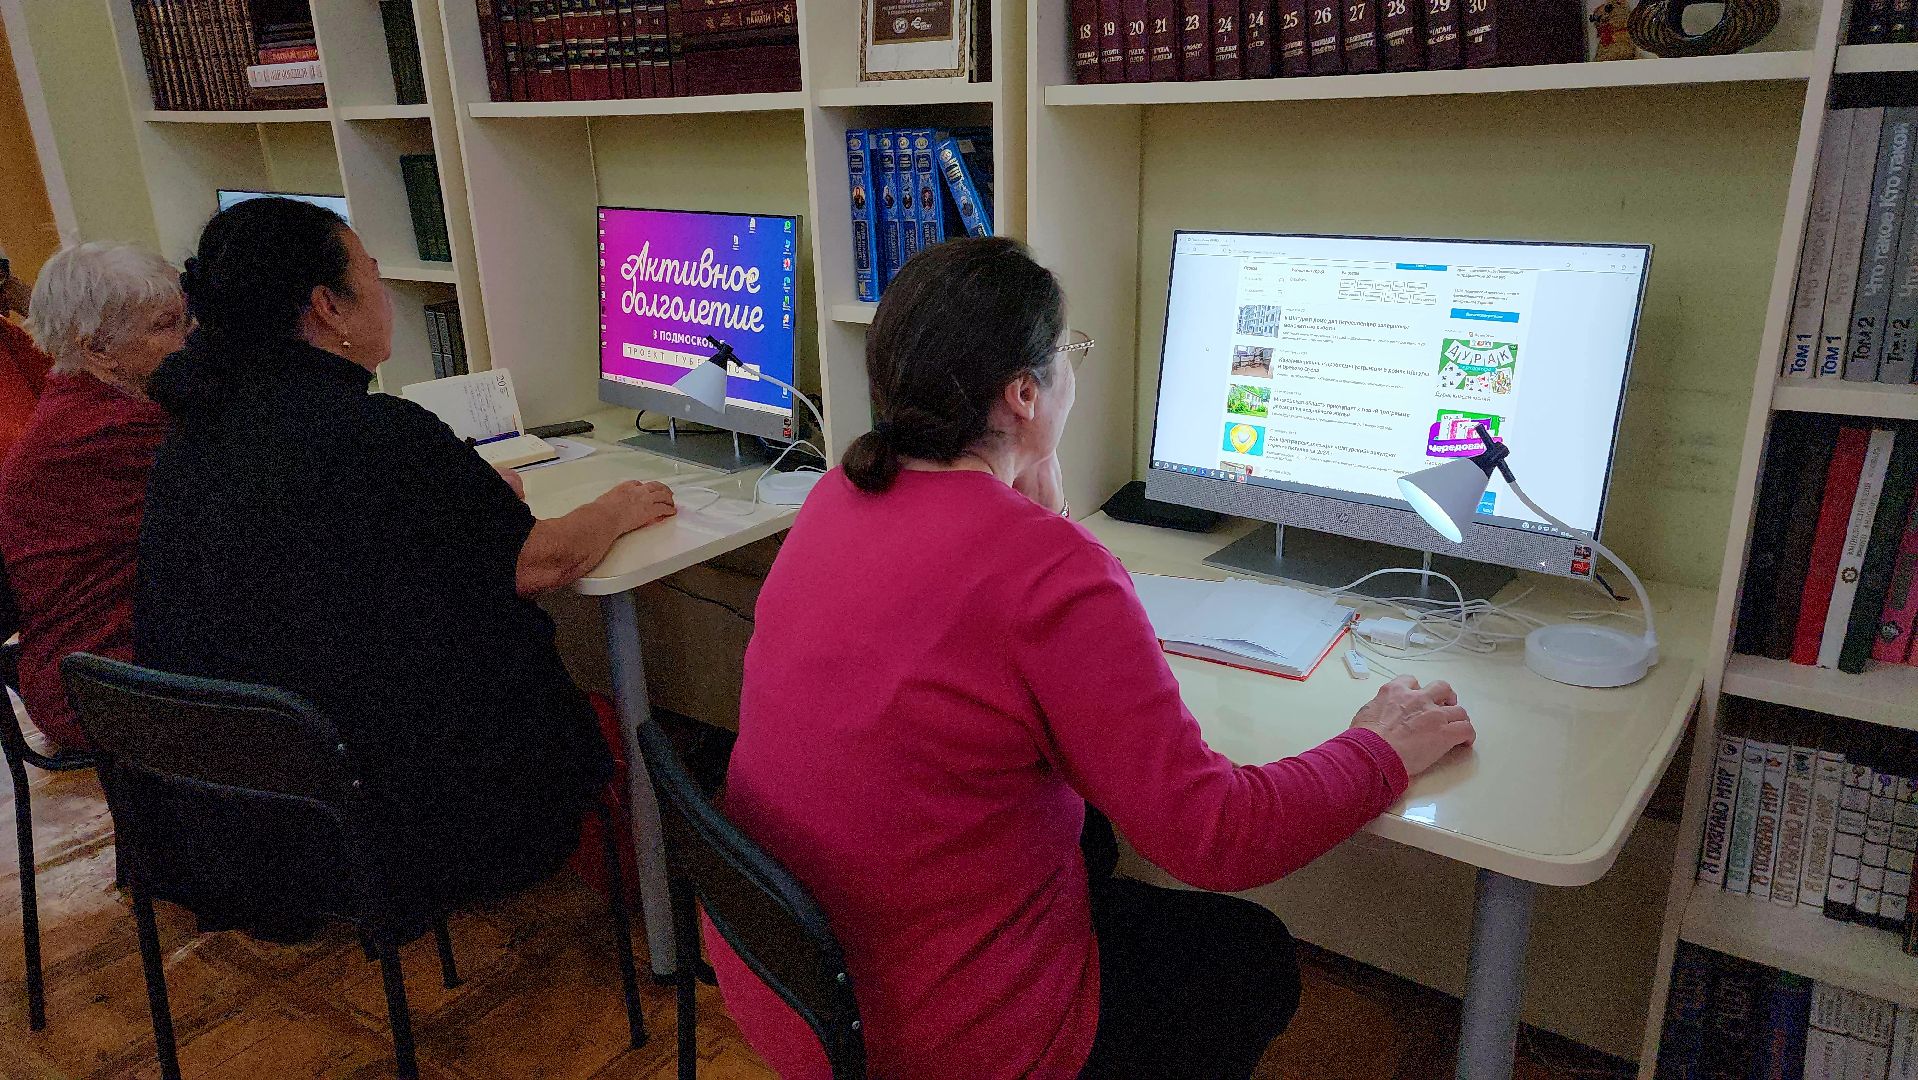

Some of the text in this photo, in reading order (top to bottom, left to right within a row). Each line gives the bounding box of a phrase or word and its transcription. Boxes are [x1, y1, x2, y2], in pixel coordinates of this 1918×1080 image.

[1349, 3, 1366, 22] 27
[1387, 0, 1406, 18] 28
[1429, 0, 1451, 15] 29
[1468, 0, 1487, 14] 30
[1184, 14, 1200, 31] 23
[1217, 16, 1232, 33] 24
[1248, 11, 1264, 29] 24
[1282, 11, 1298, 30] 25
[1314, 7, 1332, 26] 26
[1079, 24, 1091, 40] 18
[1103, 21, 1115, 37] 19
[1129, 20, 1145, 36] 20
[1155, 17, 1167, 34] 21
[621, 241, 761, 294] Активное
[621, 275, 765, 333] долголетие
[1857, 316, 1876, 328] 2
[1893, 318, 1912, 331] 2
[1448, 345, 1510, 364] ДУРАК
[1716, 766, 1736, 800] МИР
